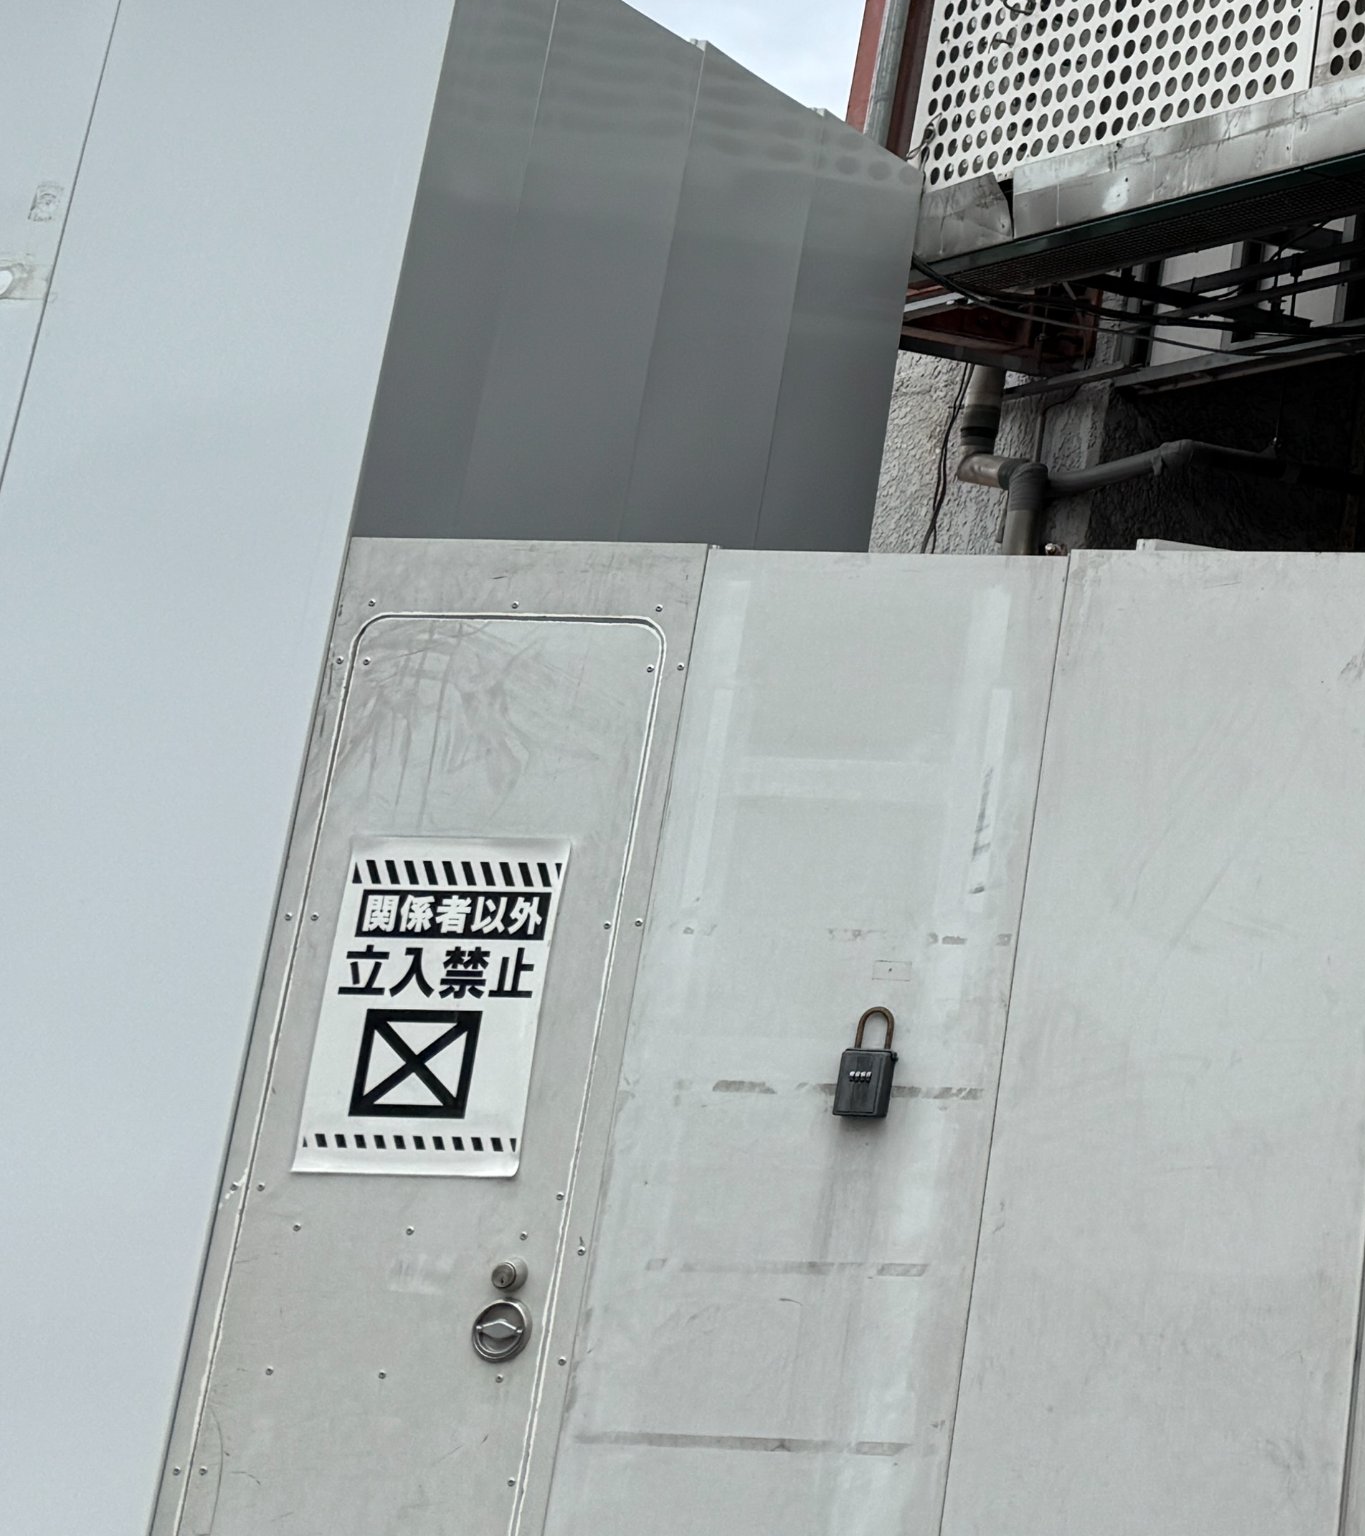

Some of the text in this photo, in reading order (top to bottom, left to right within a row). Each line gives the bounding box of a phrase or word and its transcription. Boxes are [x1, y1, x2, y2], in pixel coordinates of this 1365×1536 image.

[361, 894, 543, 935] 関係者以外
[338, 944, 535, 999] 立入禁止
